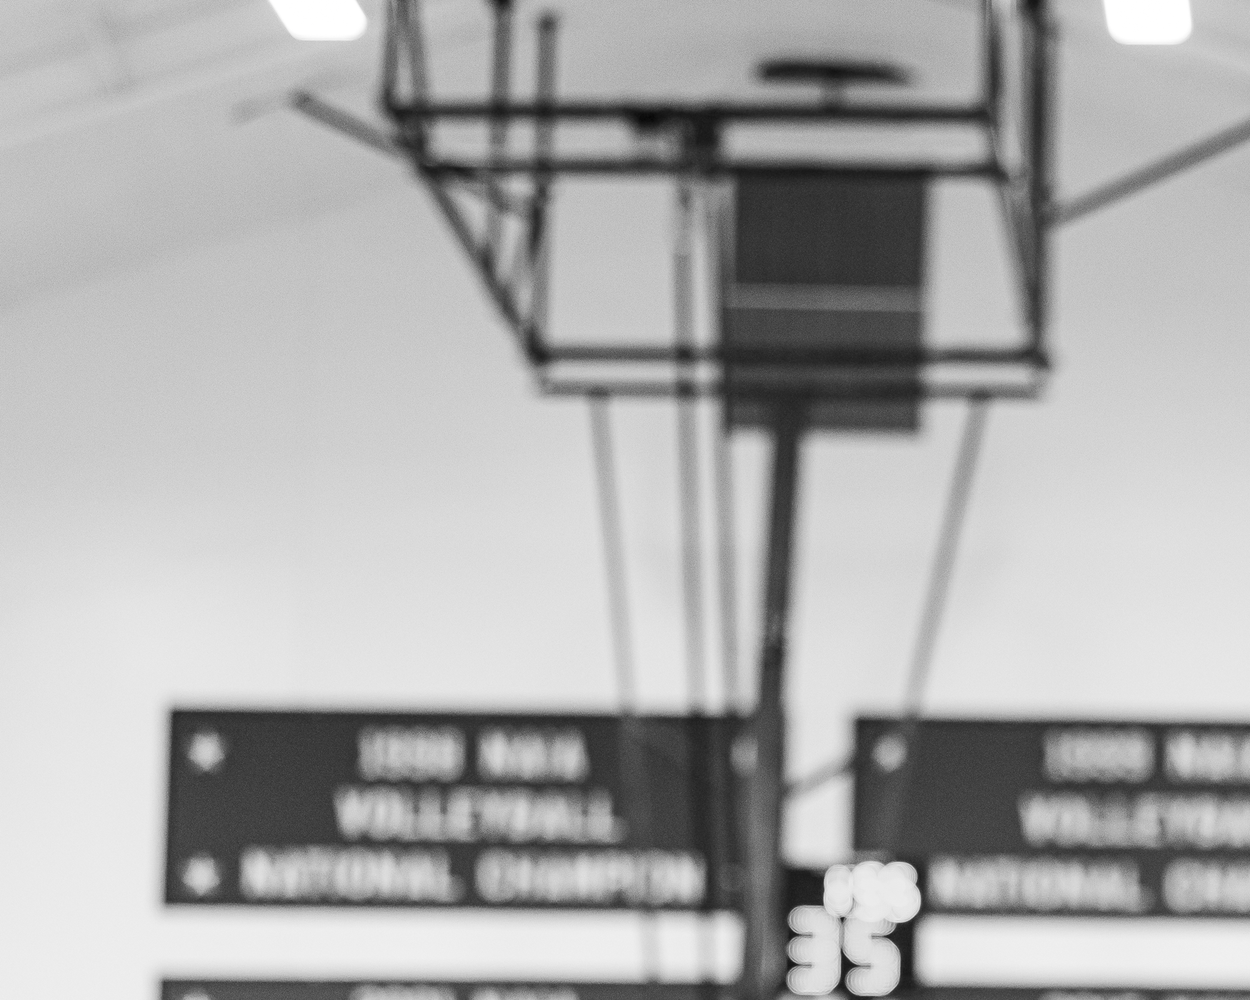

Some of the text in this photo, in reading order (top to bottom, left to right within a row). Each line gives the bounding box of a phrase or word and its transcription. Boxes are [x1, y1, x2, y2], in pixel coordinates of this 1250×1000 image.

[480, 729, 587, 779] NAIA
[336, 788, 622, 840] VOLLEYBALL
[243, 848, 703, 901] NATIONAL CHAMPION
[929, 857, 1150, 911] NATIONAL
[787, 905, 901, 996] 35
